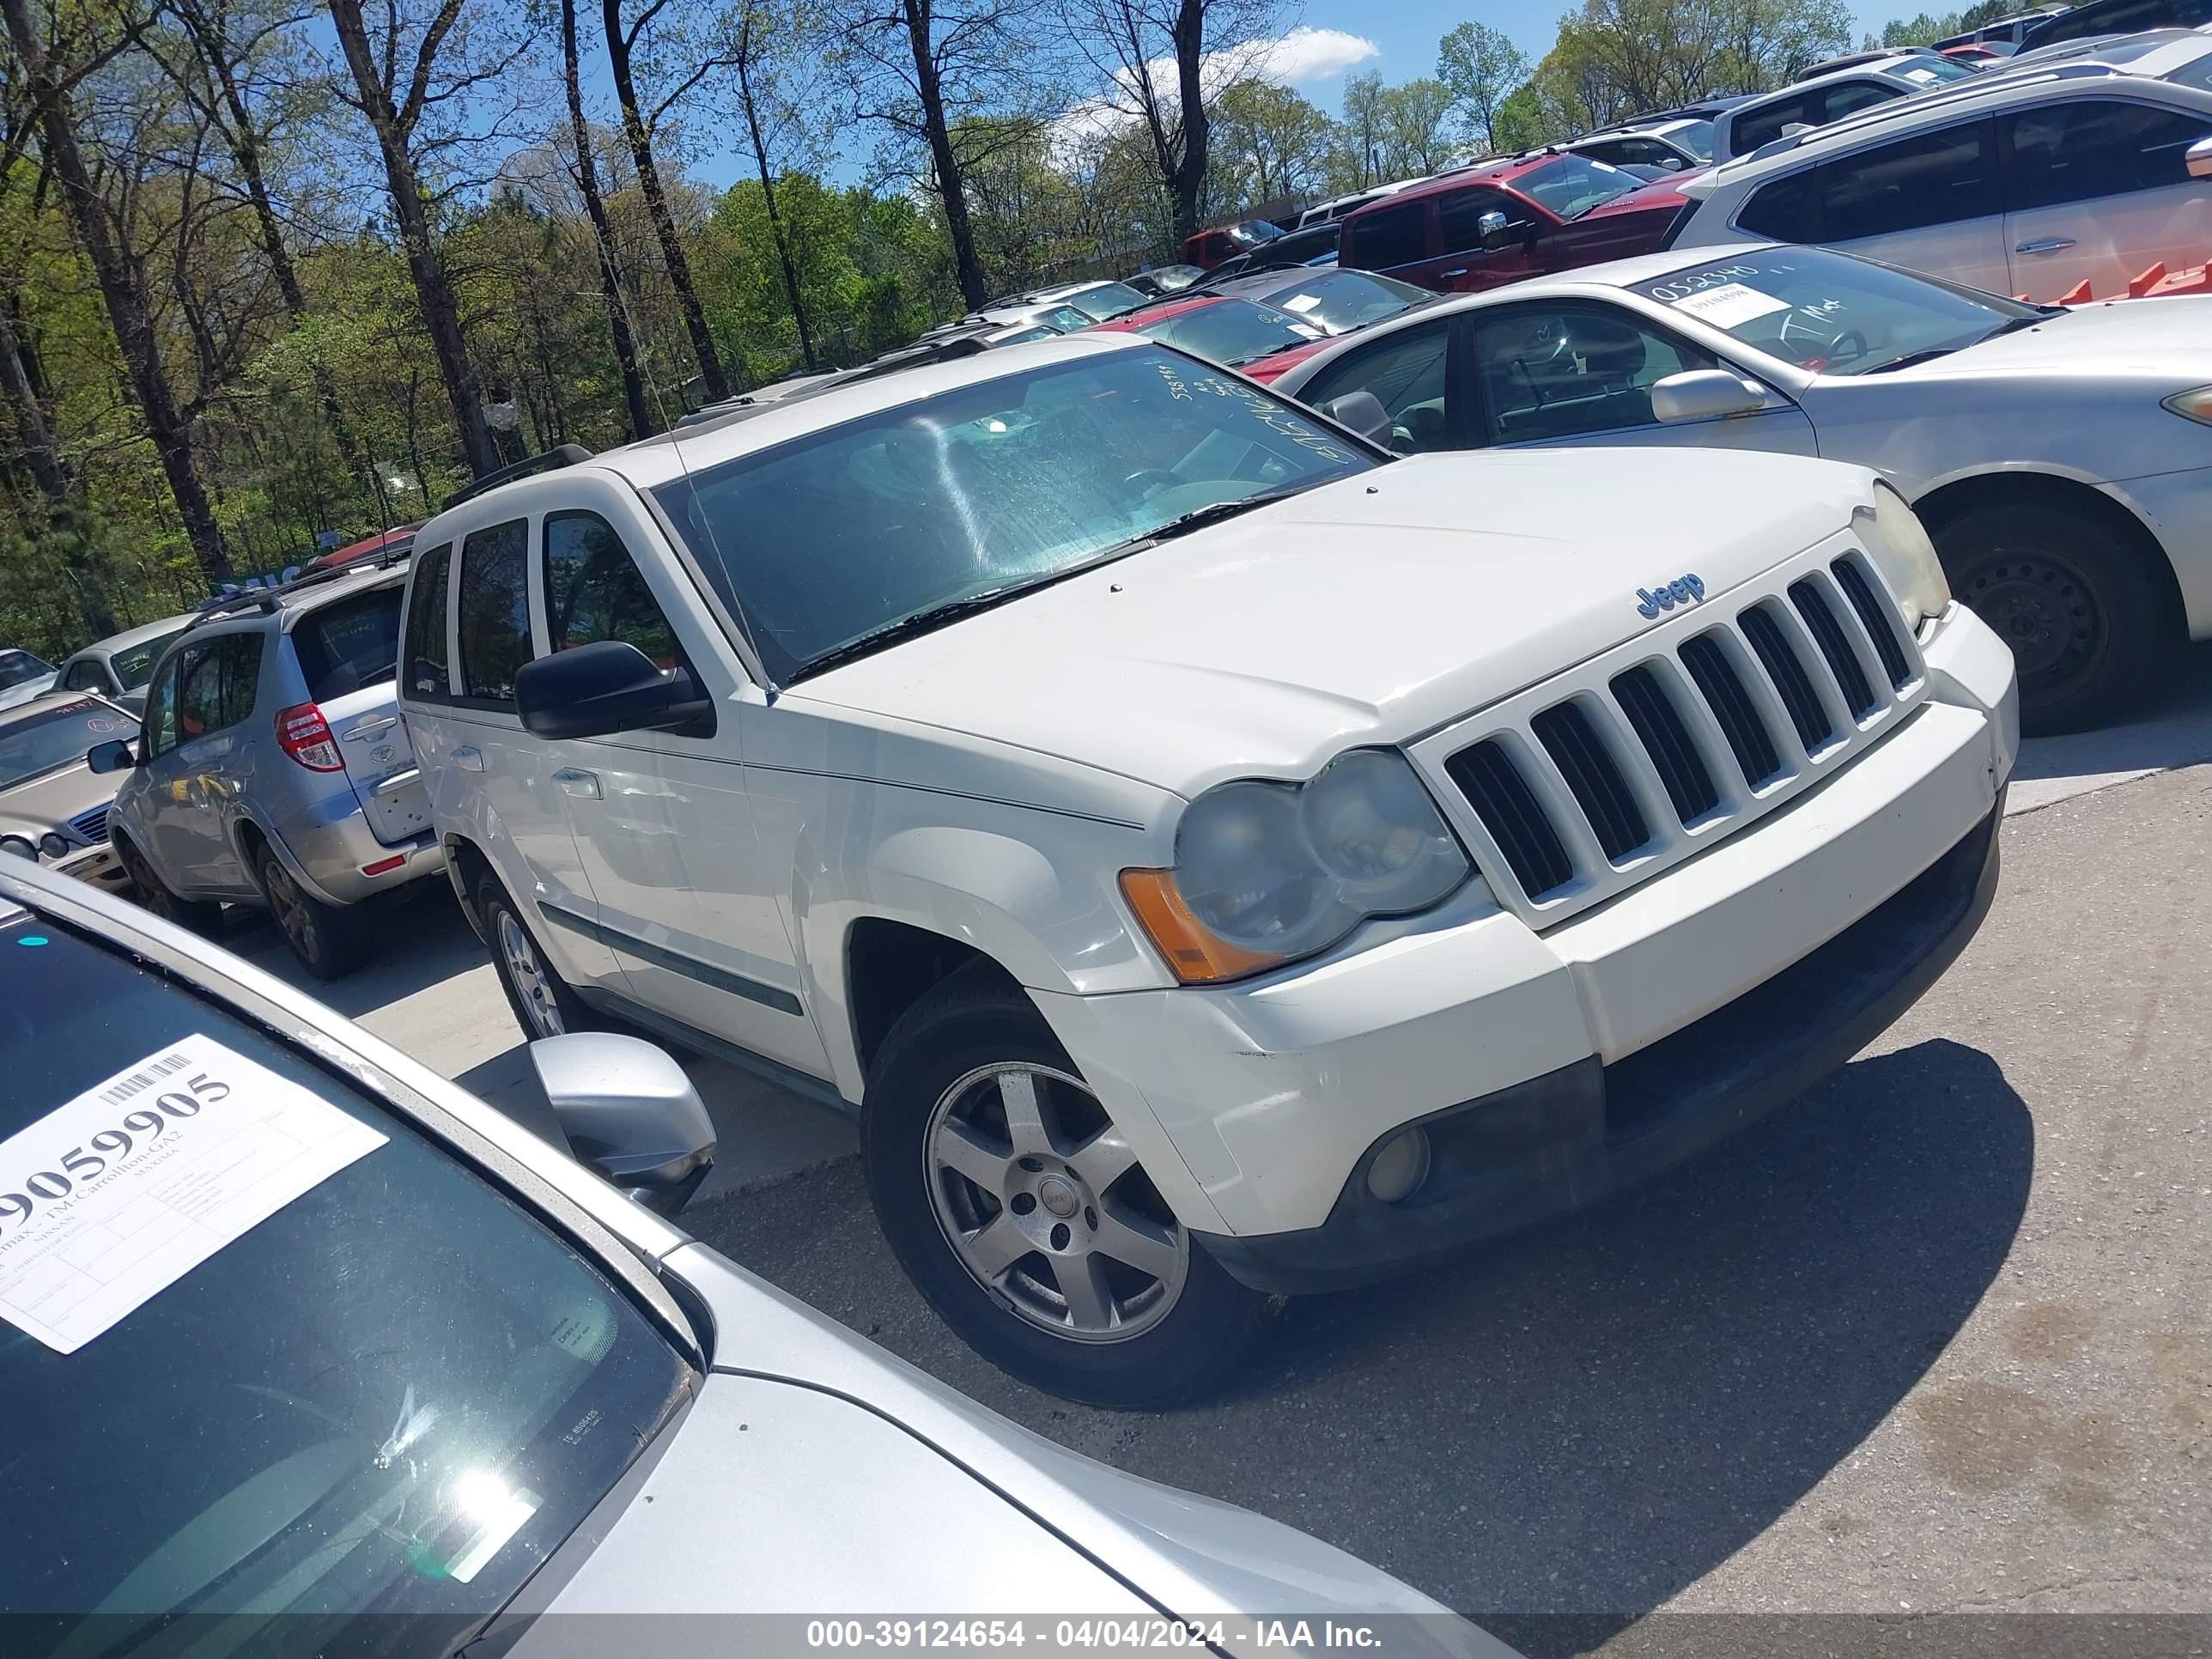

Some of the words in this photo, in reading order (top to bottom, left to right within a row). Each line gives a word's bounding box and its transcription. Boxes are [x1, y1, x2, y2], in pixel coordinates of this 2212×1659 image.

[1652, 265, 1759, 301] 052340
[1635, 572, 1705, 620] Jeep
[0, 1073, 230, 1237] 9059905
[133, 1147, 180, 1178] MAXIMA
